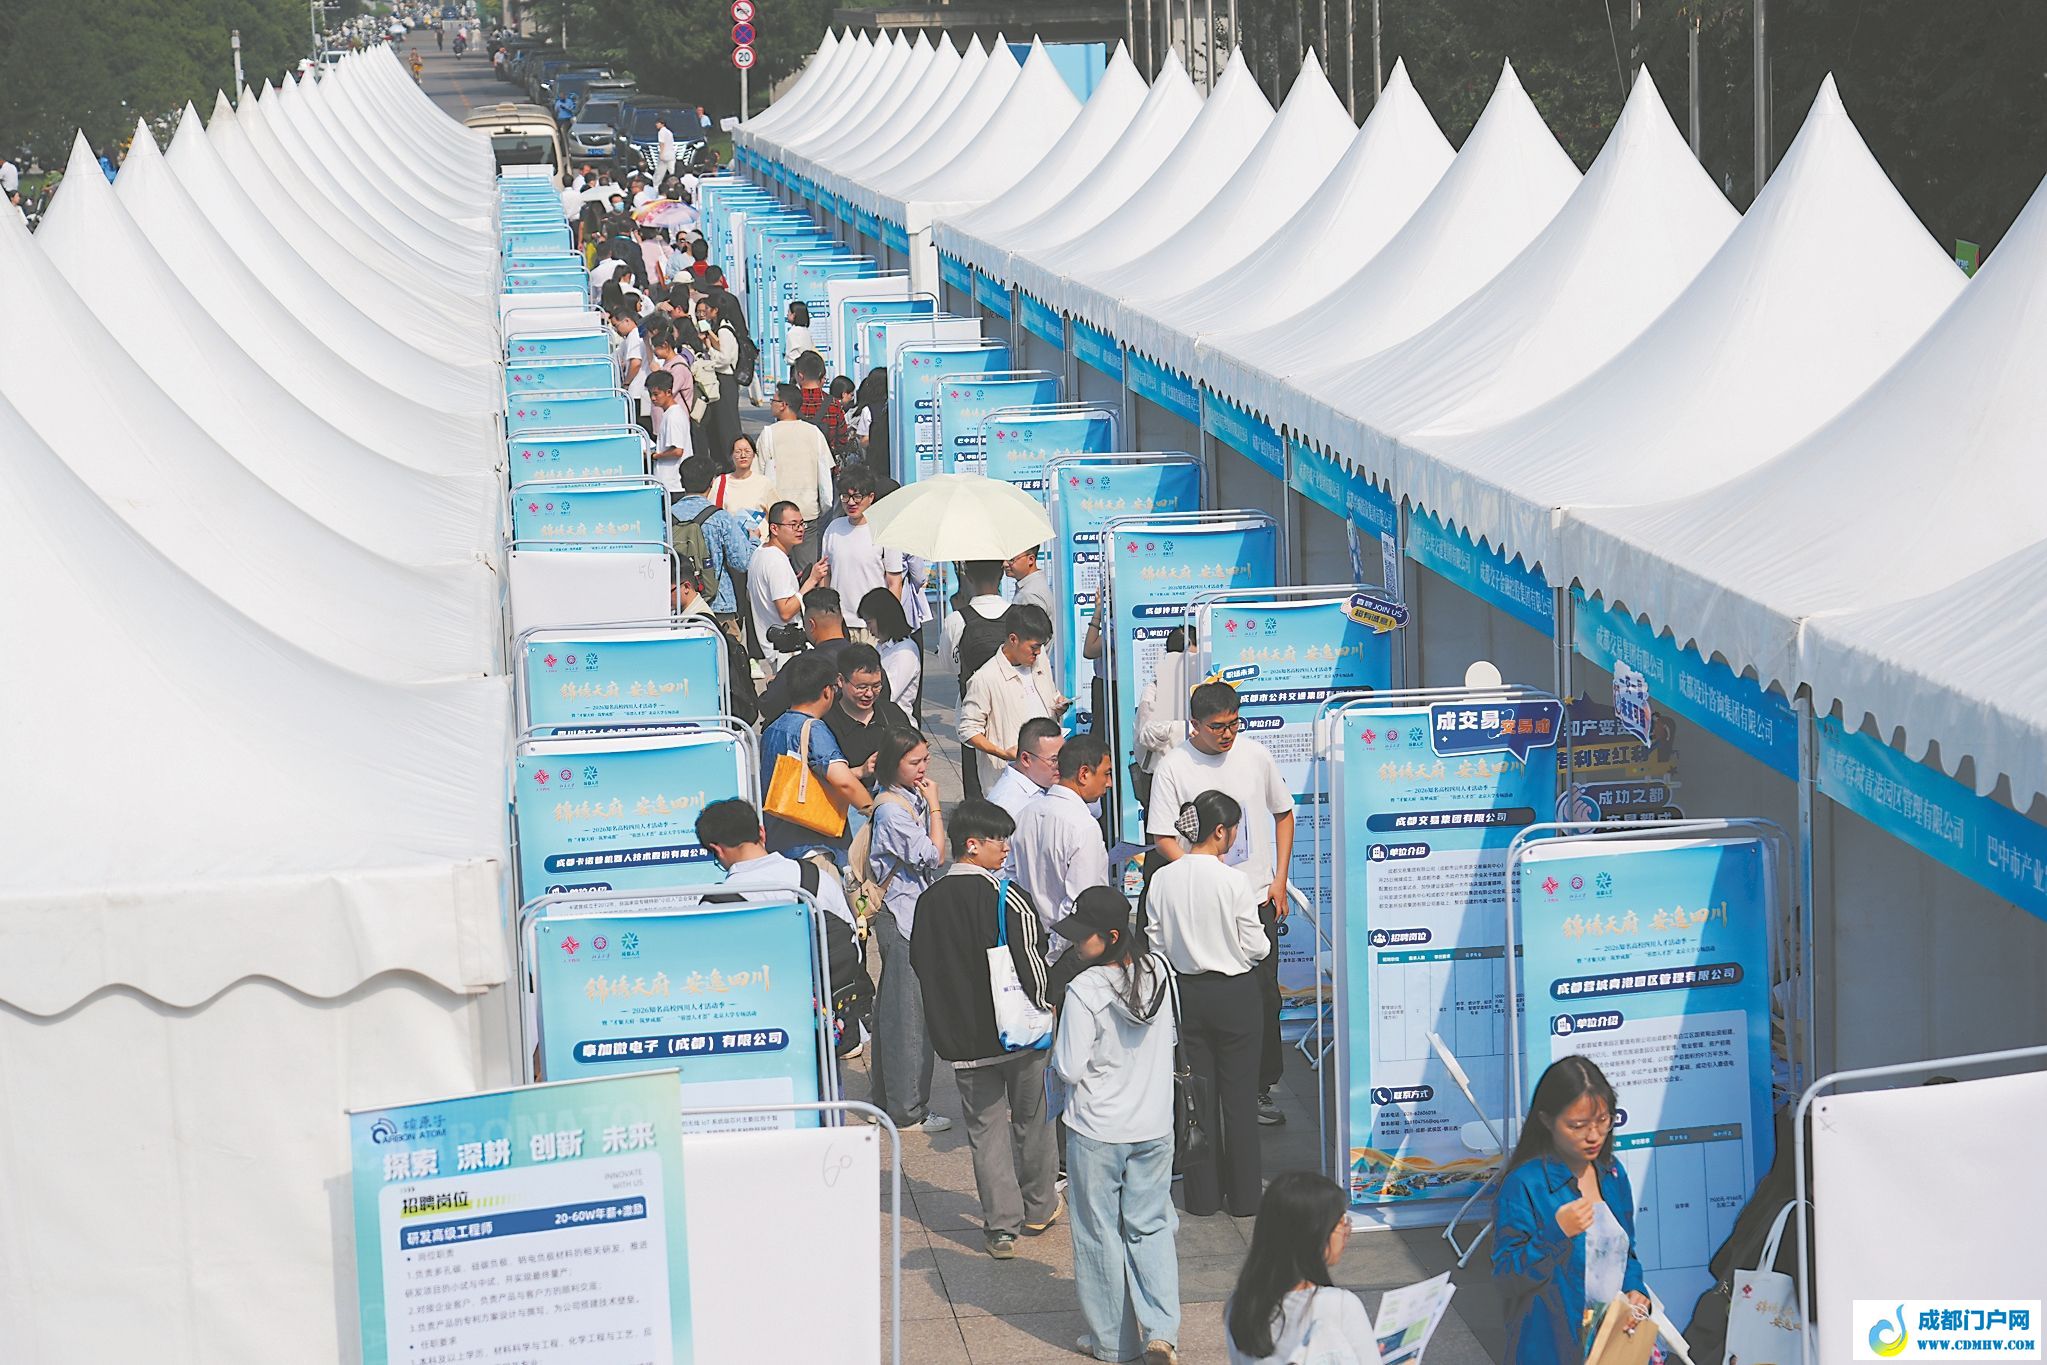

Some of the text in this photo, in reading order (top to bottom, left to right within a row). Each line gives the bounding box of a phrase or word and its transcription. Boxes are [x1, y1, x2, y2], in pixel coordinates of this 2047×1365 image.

[739, 52, 750, 62] 20
[1373, 604, 1390, 614] JOIN
[1392, 609, 1403, 618] US
[1249, 718, 1281, 728] 单位介绍
[1437, 709, 1551, 735] 成交易 交易成
[1599, 787, 1664, 806] 成功之都
[1395, 812, 1508, 828] 成都交易集团有限公司
[556, 847, 709, 869] 成都卡诺普机器人技术股份有限公司
[1390, 846, 1426, 857] 单位介绍
[1988, 834, 2047, 895] 巴中市产业
[1391, 932, 1427, 943] 招聘岗位
[1576, 1015, 1619, 1029] 单位介绍
[1393, 1089, 1429, 1100] 联系方式
[419, 1129, 447, 1140] ATOM
[384, 1148, 439, 1181] 探索
[457, 1138, 512, 1171] 深耕
[530, 1129, 584, 1162] 创新
[602, 1122, 656, 1153] 未来
[604, 1168, 643, 1180] INNOVATE
[612, 1178, 644, 1190] WITH US
[402, 1191, 469, 1215] 招聘岗位
[406, 1220, 494, 1247] 研发高级工程师
